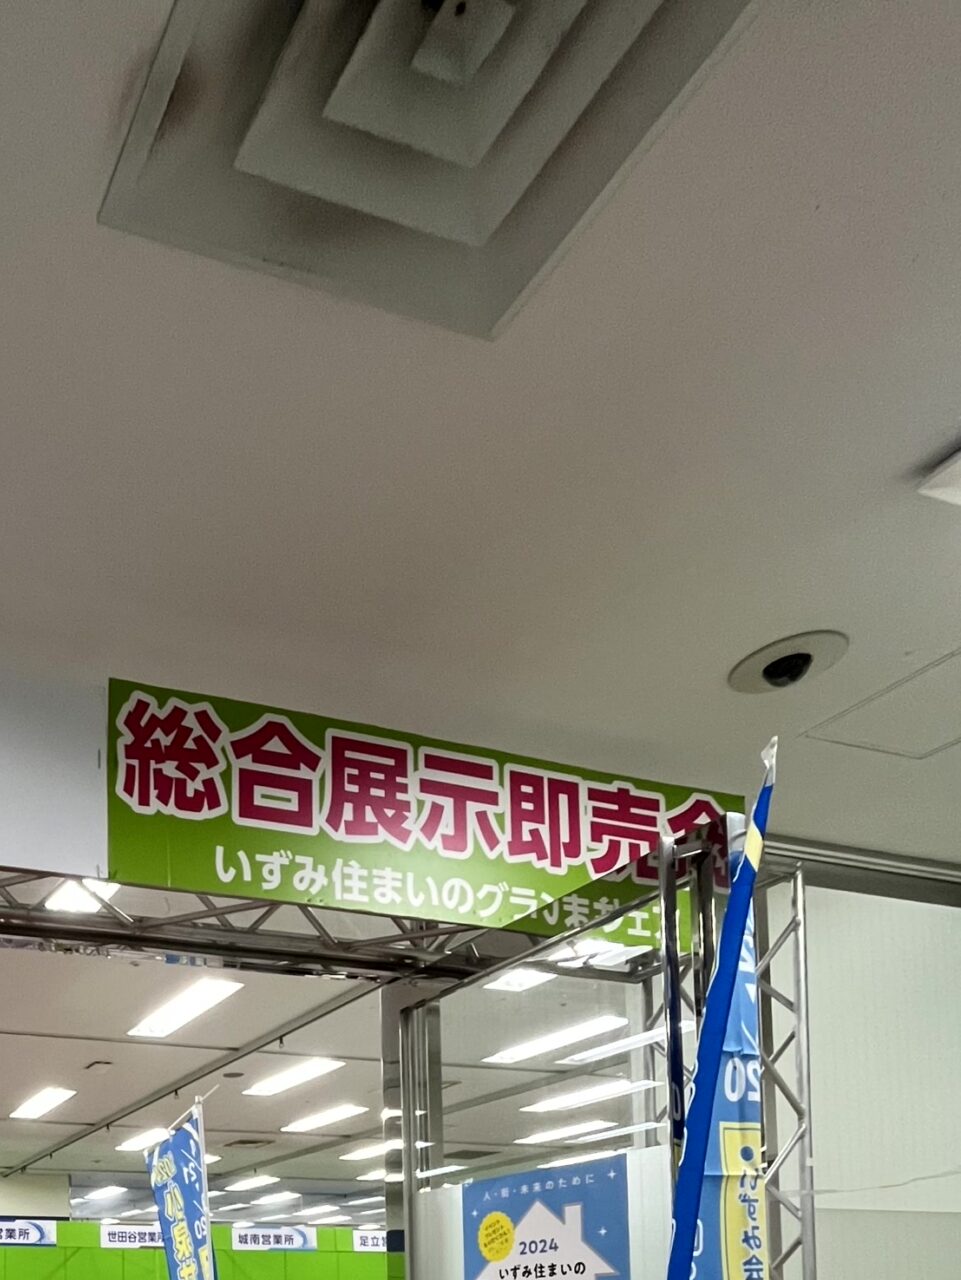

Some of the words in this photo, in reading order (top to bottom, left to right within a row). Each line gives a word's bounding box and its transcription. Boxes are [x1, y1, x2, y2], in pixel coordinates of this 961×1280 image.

[238, 1233, 294, 1246] 城南営業所
[518, 1238, 559, 1256] 2024
[498, 1260, 586, 1280] いずみ住まいの
